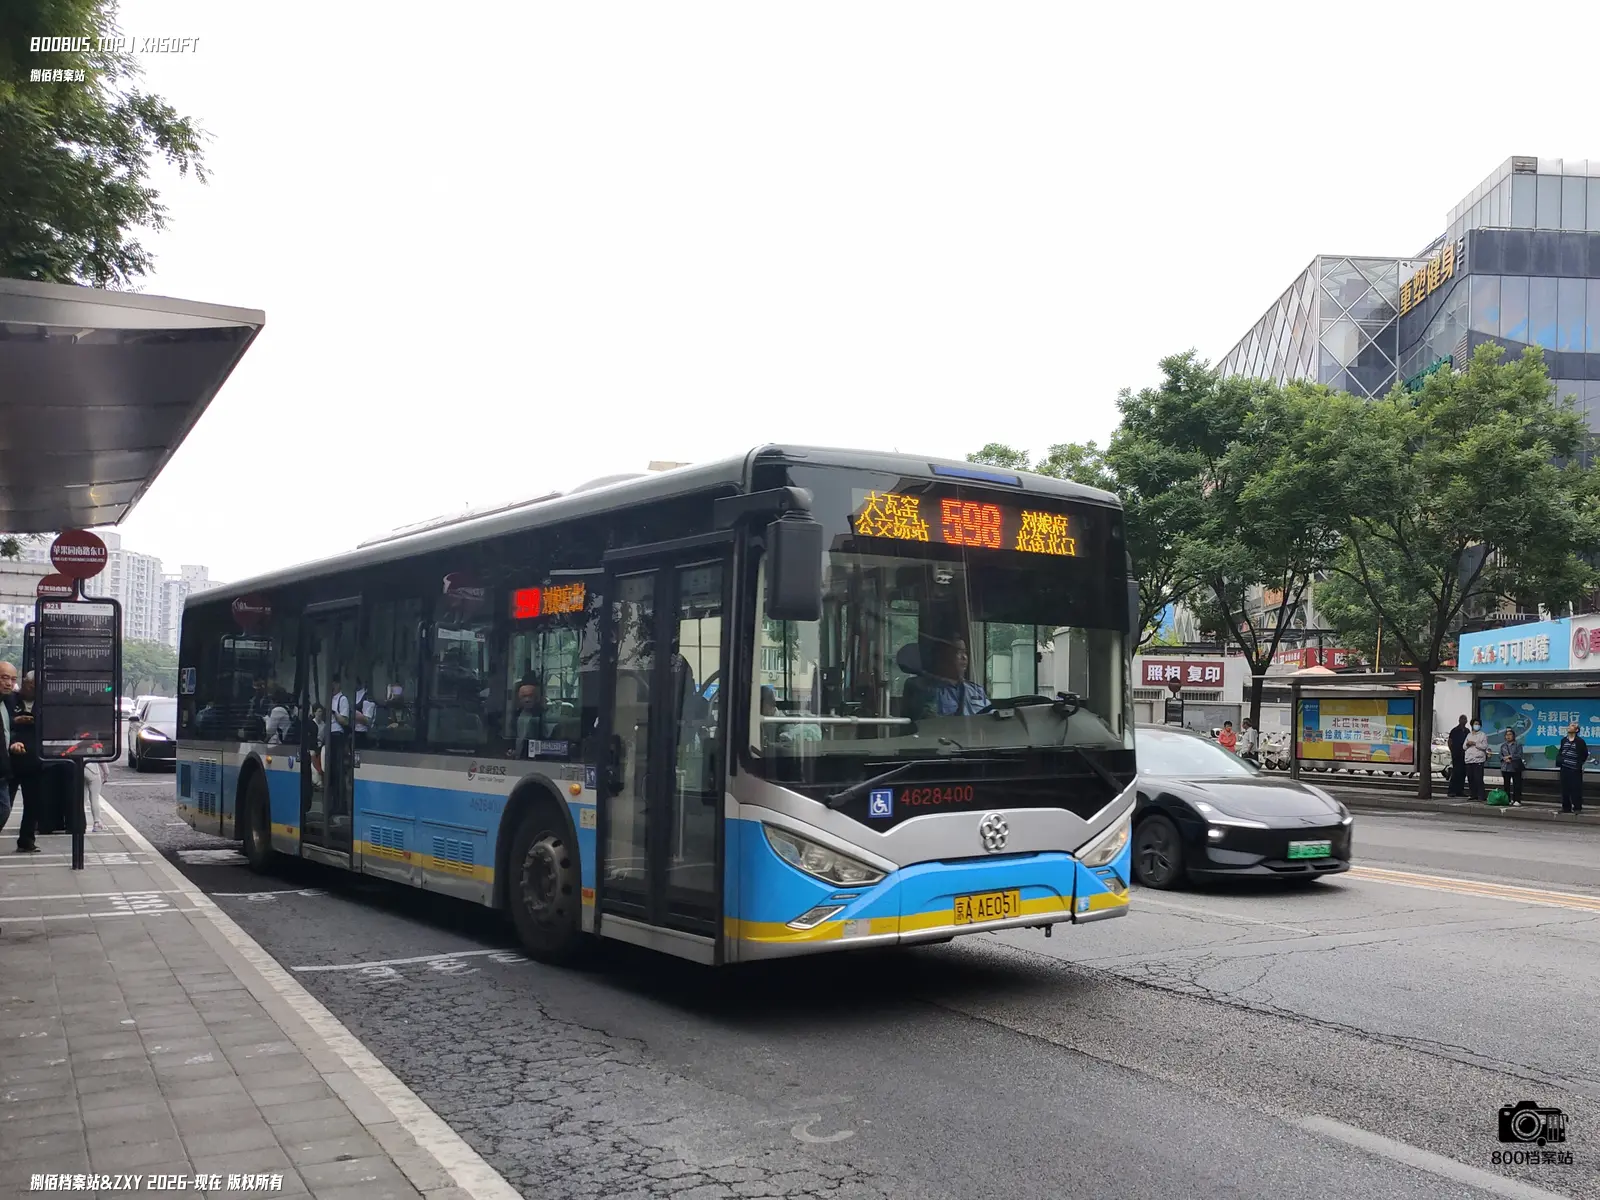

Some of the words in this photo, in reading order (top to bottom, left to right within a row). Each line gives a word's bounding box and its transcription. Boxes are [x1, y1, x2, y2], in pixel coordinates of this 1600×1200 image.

[1400, 244, 1456, 318] 重塑健身
[863, 490, 920, 520] 大瓦窑
[855, 511, 930, 542] 公交场站
[941, 498, 1003, 549] 598
[1020, 510, 1070, 537] 刘娘府
[53, 545, 105, 556] 苹果园南路东口
[1015, 531, 1076, 556] 北街北口
[1499, 634, 1551, 665] 可可眼镜
[1147, 664, 1181, 681] 照相
[1187, 665, 1221, 683] 复印
[1537, 710, 1580, 723] 与我同行
[1537, 724, 1600, 738] 共赴每站精
[900, 785, 975, 806] 4628400
